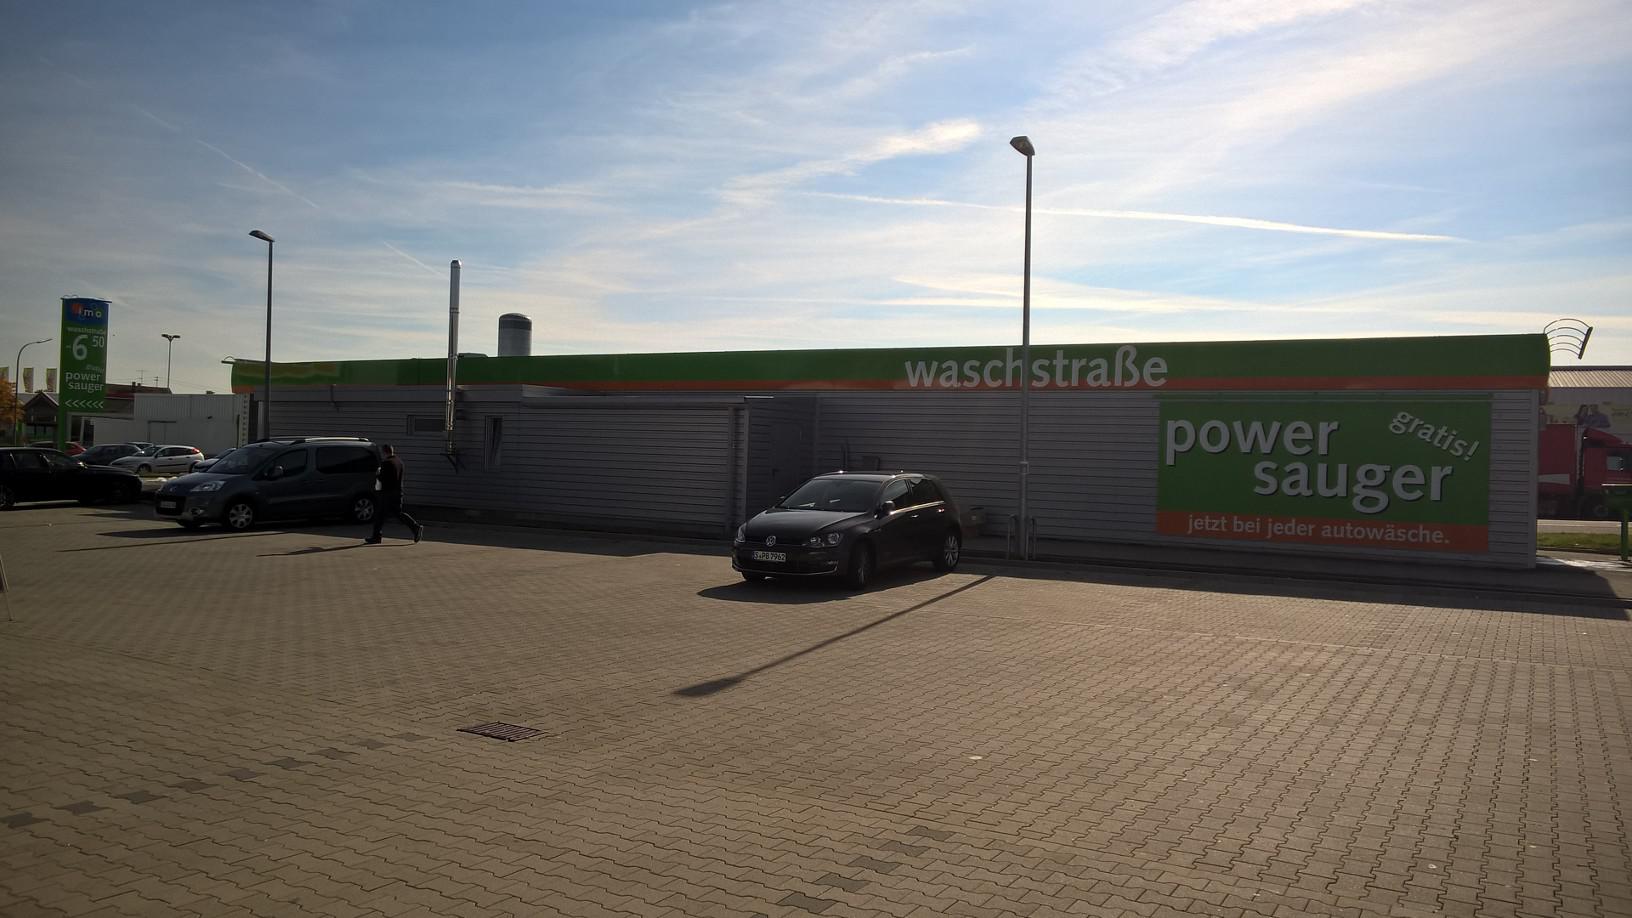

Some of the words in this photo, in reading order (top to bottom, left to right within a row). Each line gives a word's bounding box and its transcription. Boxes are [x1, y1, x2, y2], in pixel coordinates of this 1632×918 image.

[73, 334, 88, 361] 6
[91, 335, 105, 348] 50
[65, 371, 101, 383] power
[905, 345, 1168, 388] waschstraße
[68, 381, 105, 394] sauger
[1165, 418, 1340, 467] power
[1388, 410, 1480, 462] gratis!
[1254, 460, 1454, 515] sauger
[1187, 514, 1228, 535] jetzt
[1232, 516, 1261, 535] bei
[1266, 517, 1315, 539] jeder
[1320, 521, 1451, 545] autowäsche.
